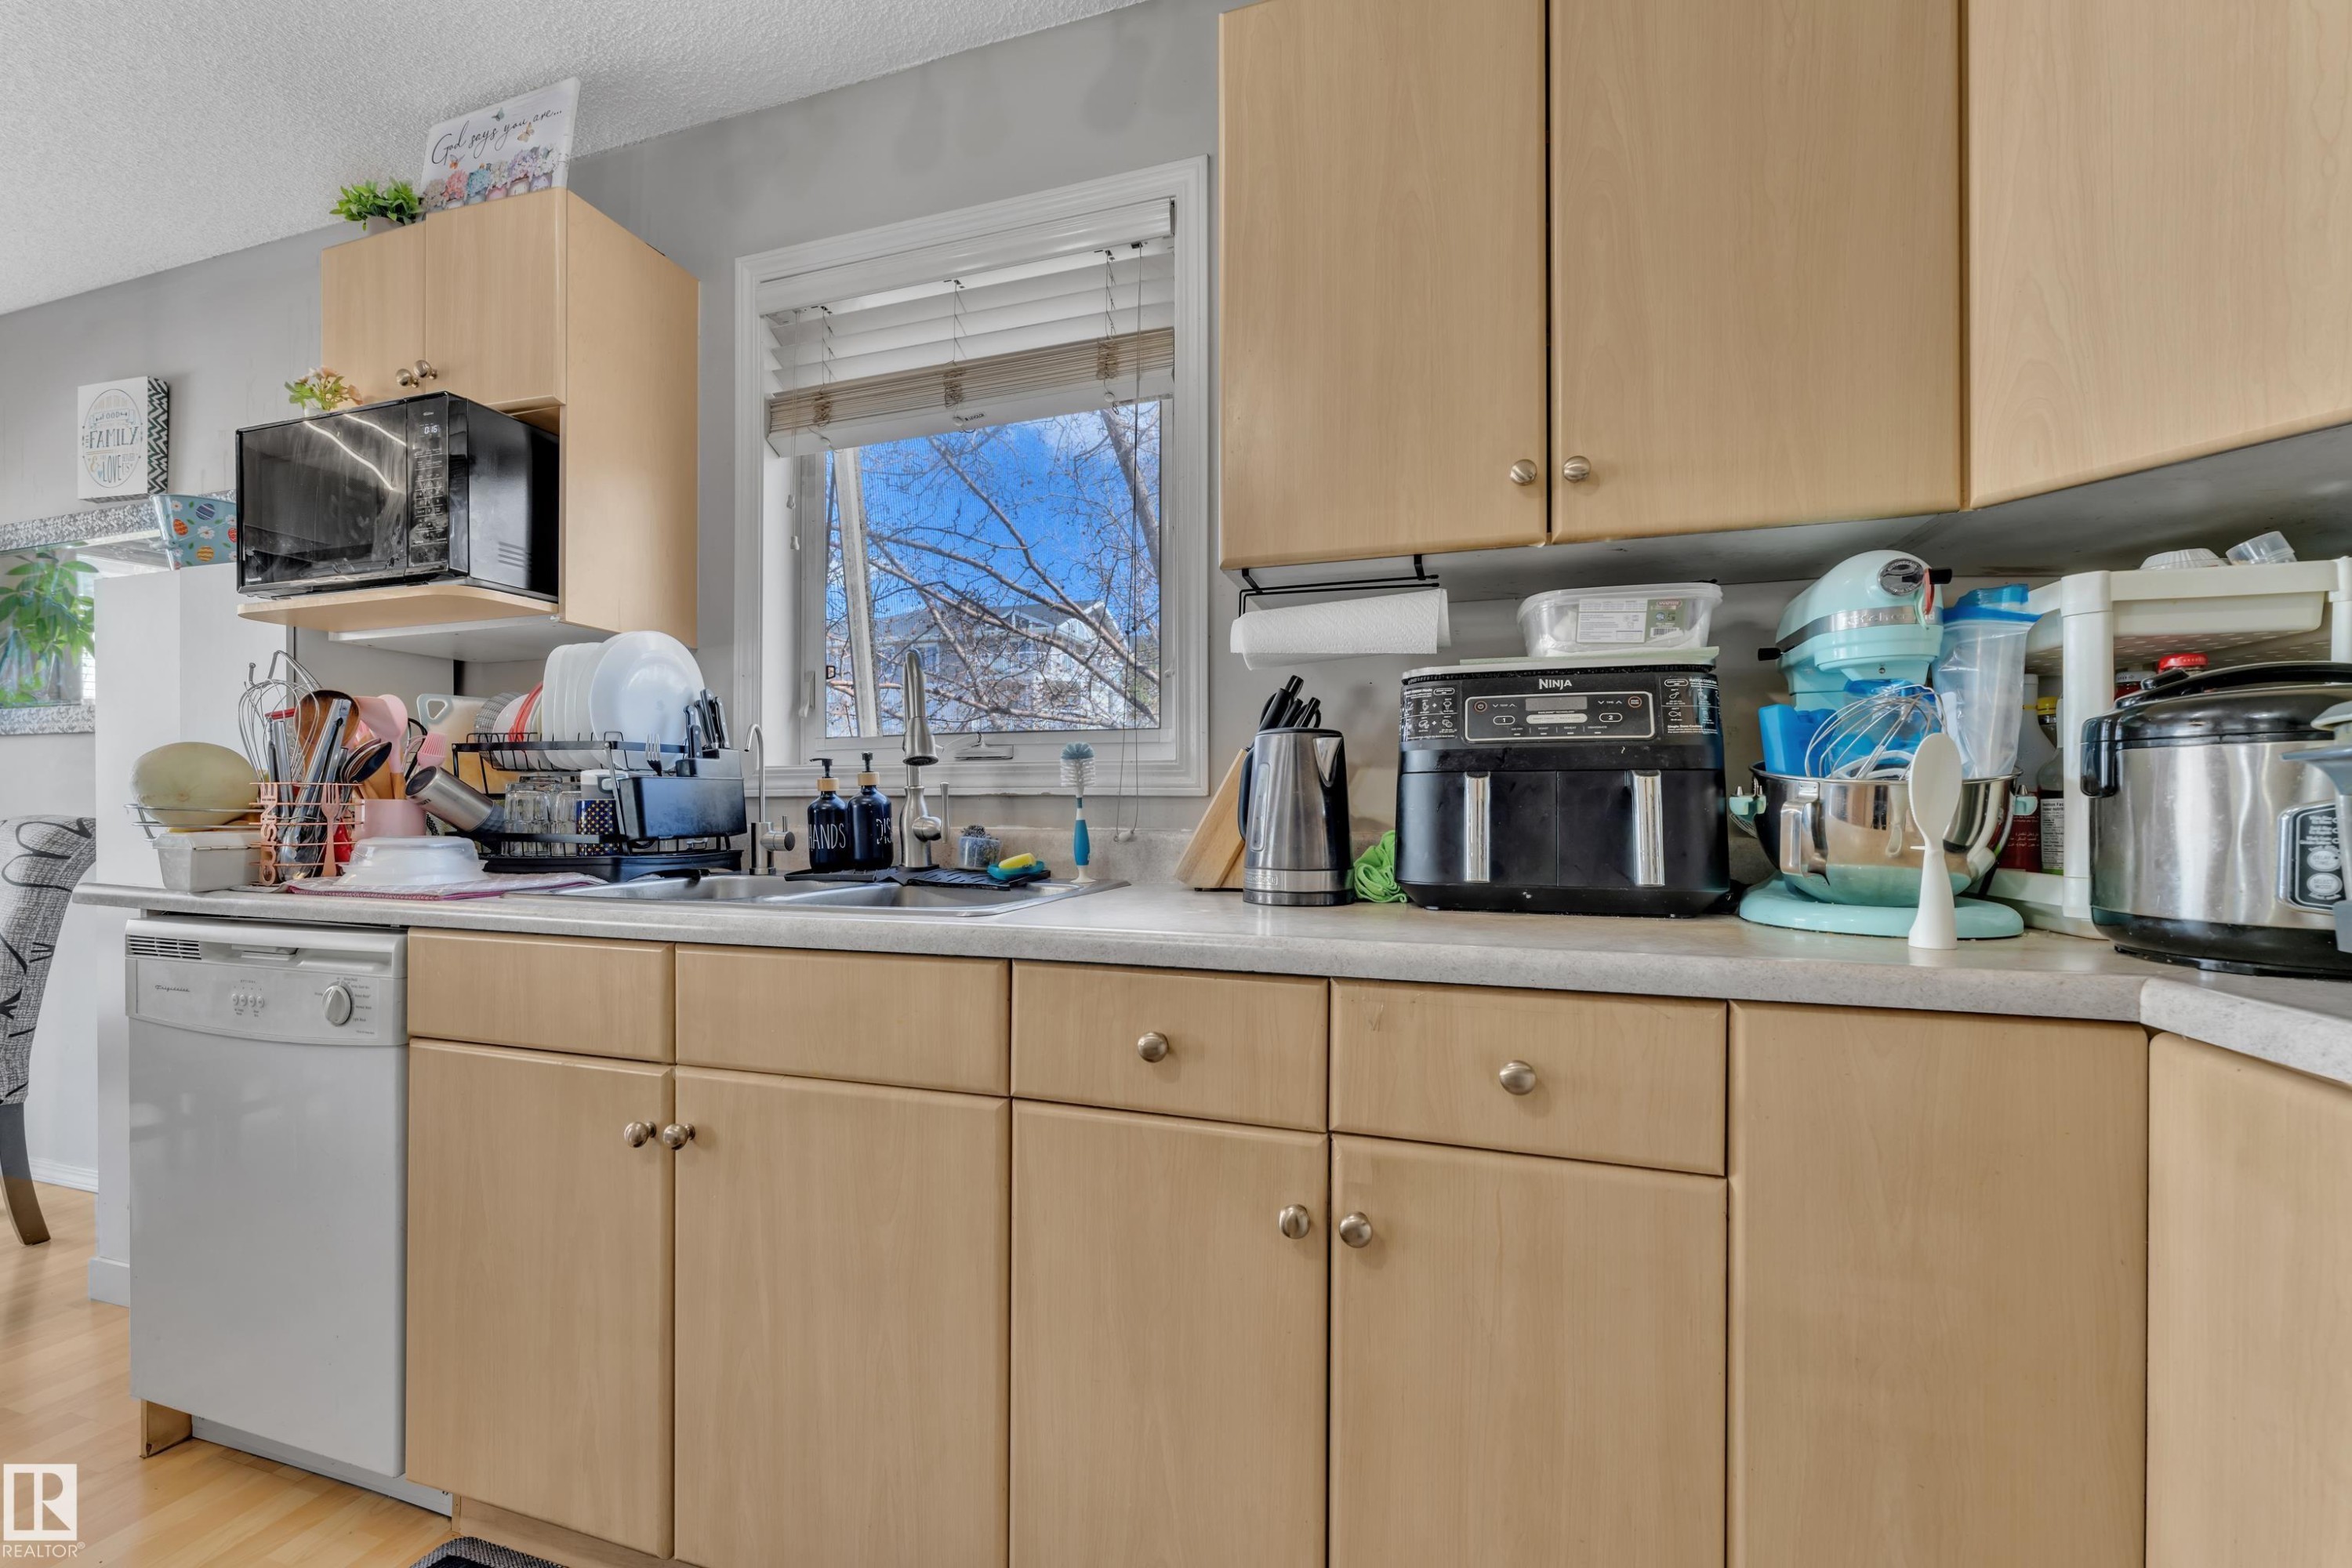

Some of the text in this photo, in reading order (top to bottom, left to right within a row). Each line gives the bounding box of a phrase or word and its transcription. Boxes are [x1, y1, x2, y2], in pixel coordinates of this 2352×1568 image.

[431, 120, 470, 165] God
[469, 127, 499, 159] says
[494, 120, 528, 151] you
[101, 410, 121, 420] FOOD
[89, 426, 140, 449] FAMILY
[103, 454, 122, 484] LOVE
[1538, 678, 1573, 691] NINJA
[808, 822, 846, 850] HANDS
